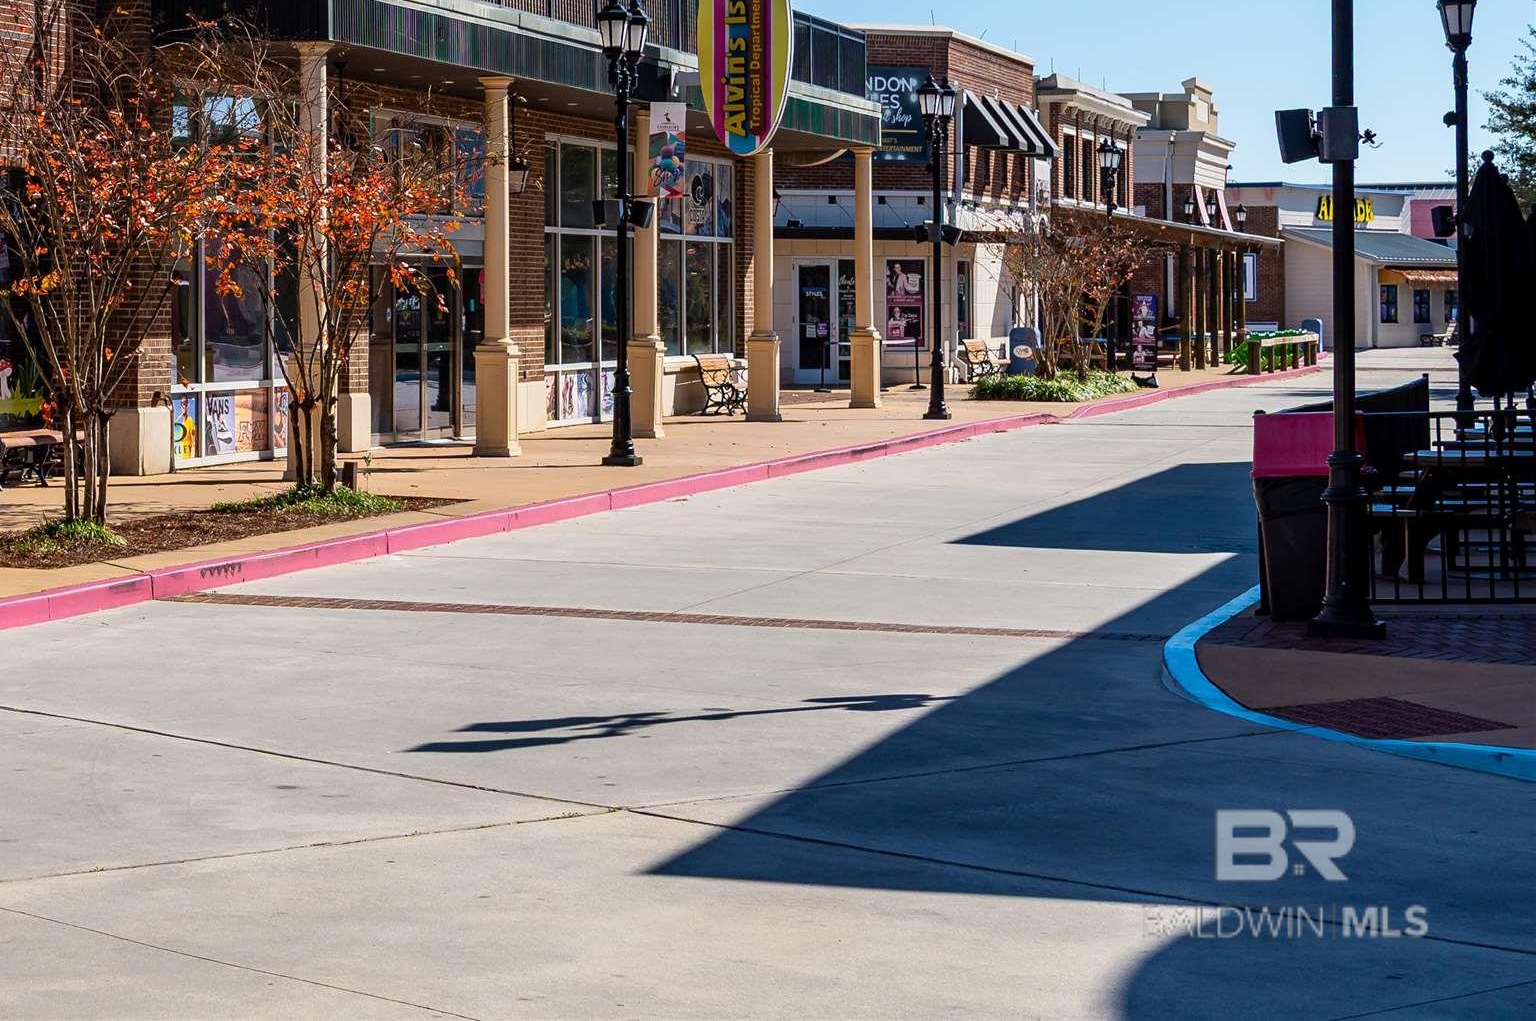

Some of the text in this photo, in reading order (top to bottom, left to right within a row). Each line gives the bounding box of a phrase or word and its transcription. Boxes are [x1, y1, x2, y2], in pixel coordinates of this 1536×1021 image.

[722, 35, 747, 137] Alvin's
[750, 73, 763, 129] Tropical
[865, 76, 913, 92] NDON
[206, 397, 230, 415] VANS
